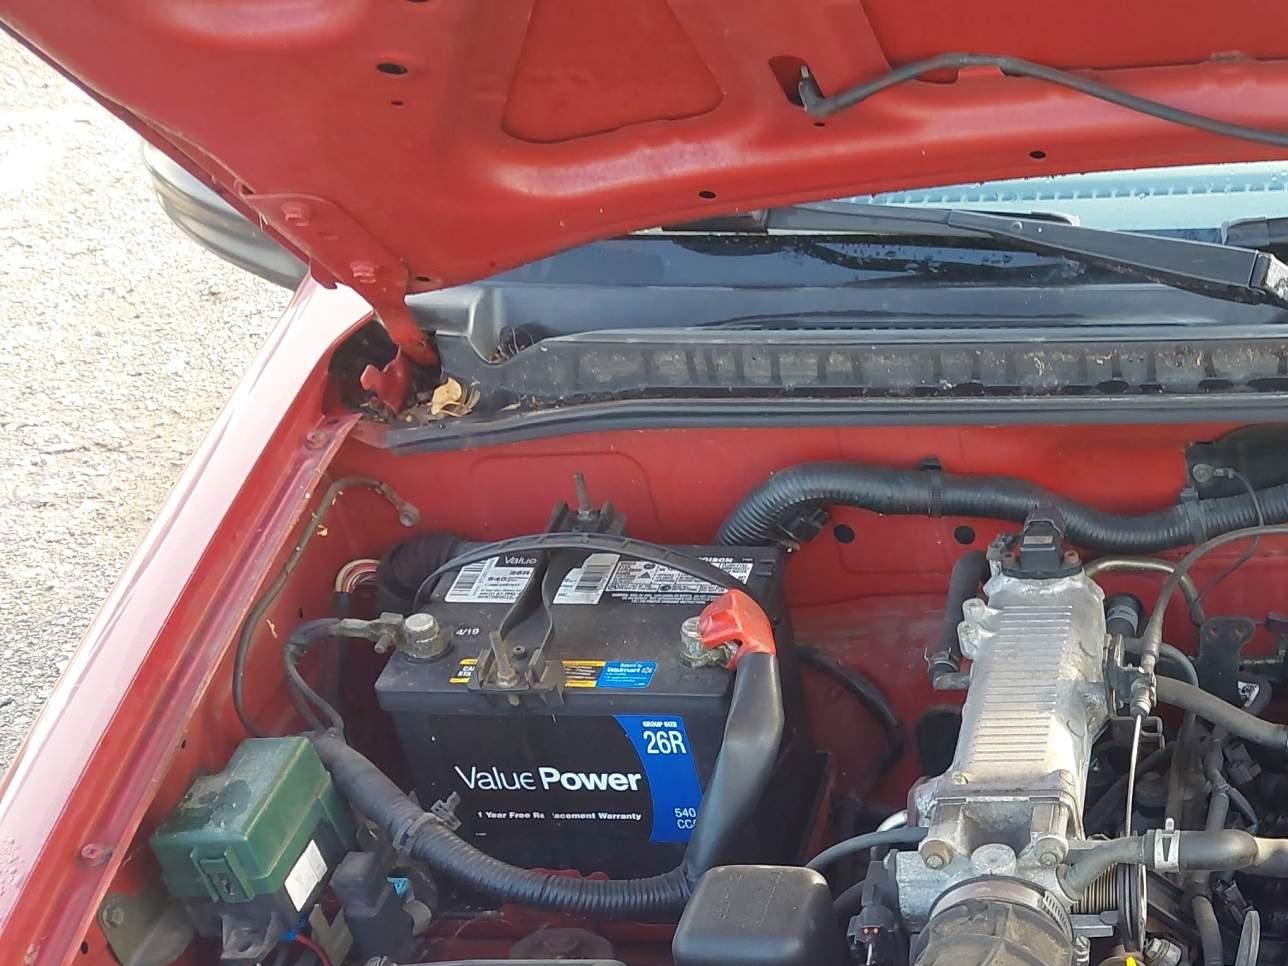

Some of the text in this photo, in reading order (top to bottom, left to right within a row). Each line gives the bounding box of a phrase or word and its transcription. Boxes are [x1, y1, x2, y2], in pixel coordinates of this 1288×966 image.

[456, 628, 480, 636] 4/19
[643, 730, 687, 755] 26R
[453, 765, 642, 792] Value Power
[477, 811, 483, 819] 1
[485, 811, 508, 819] Year
[508, 811, 531, 820] Free
[597, 812, 642, 821] Warranty
[674, 807, 697, 818] 540
